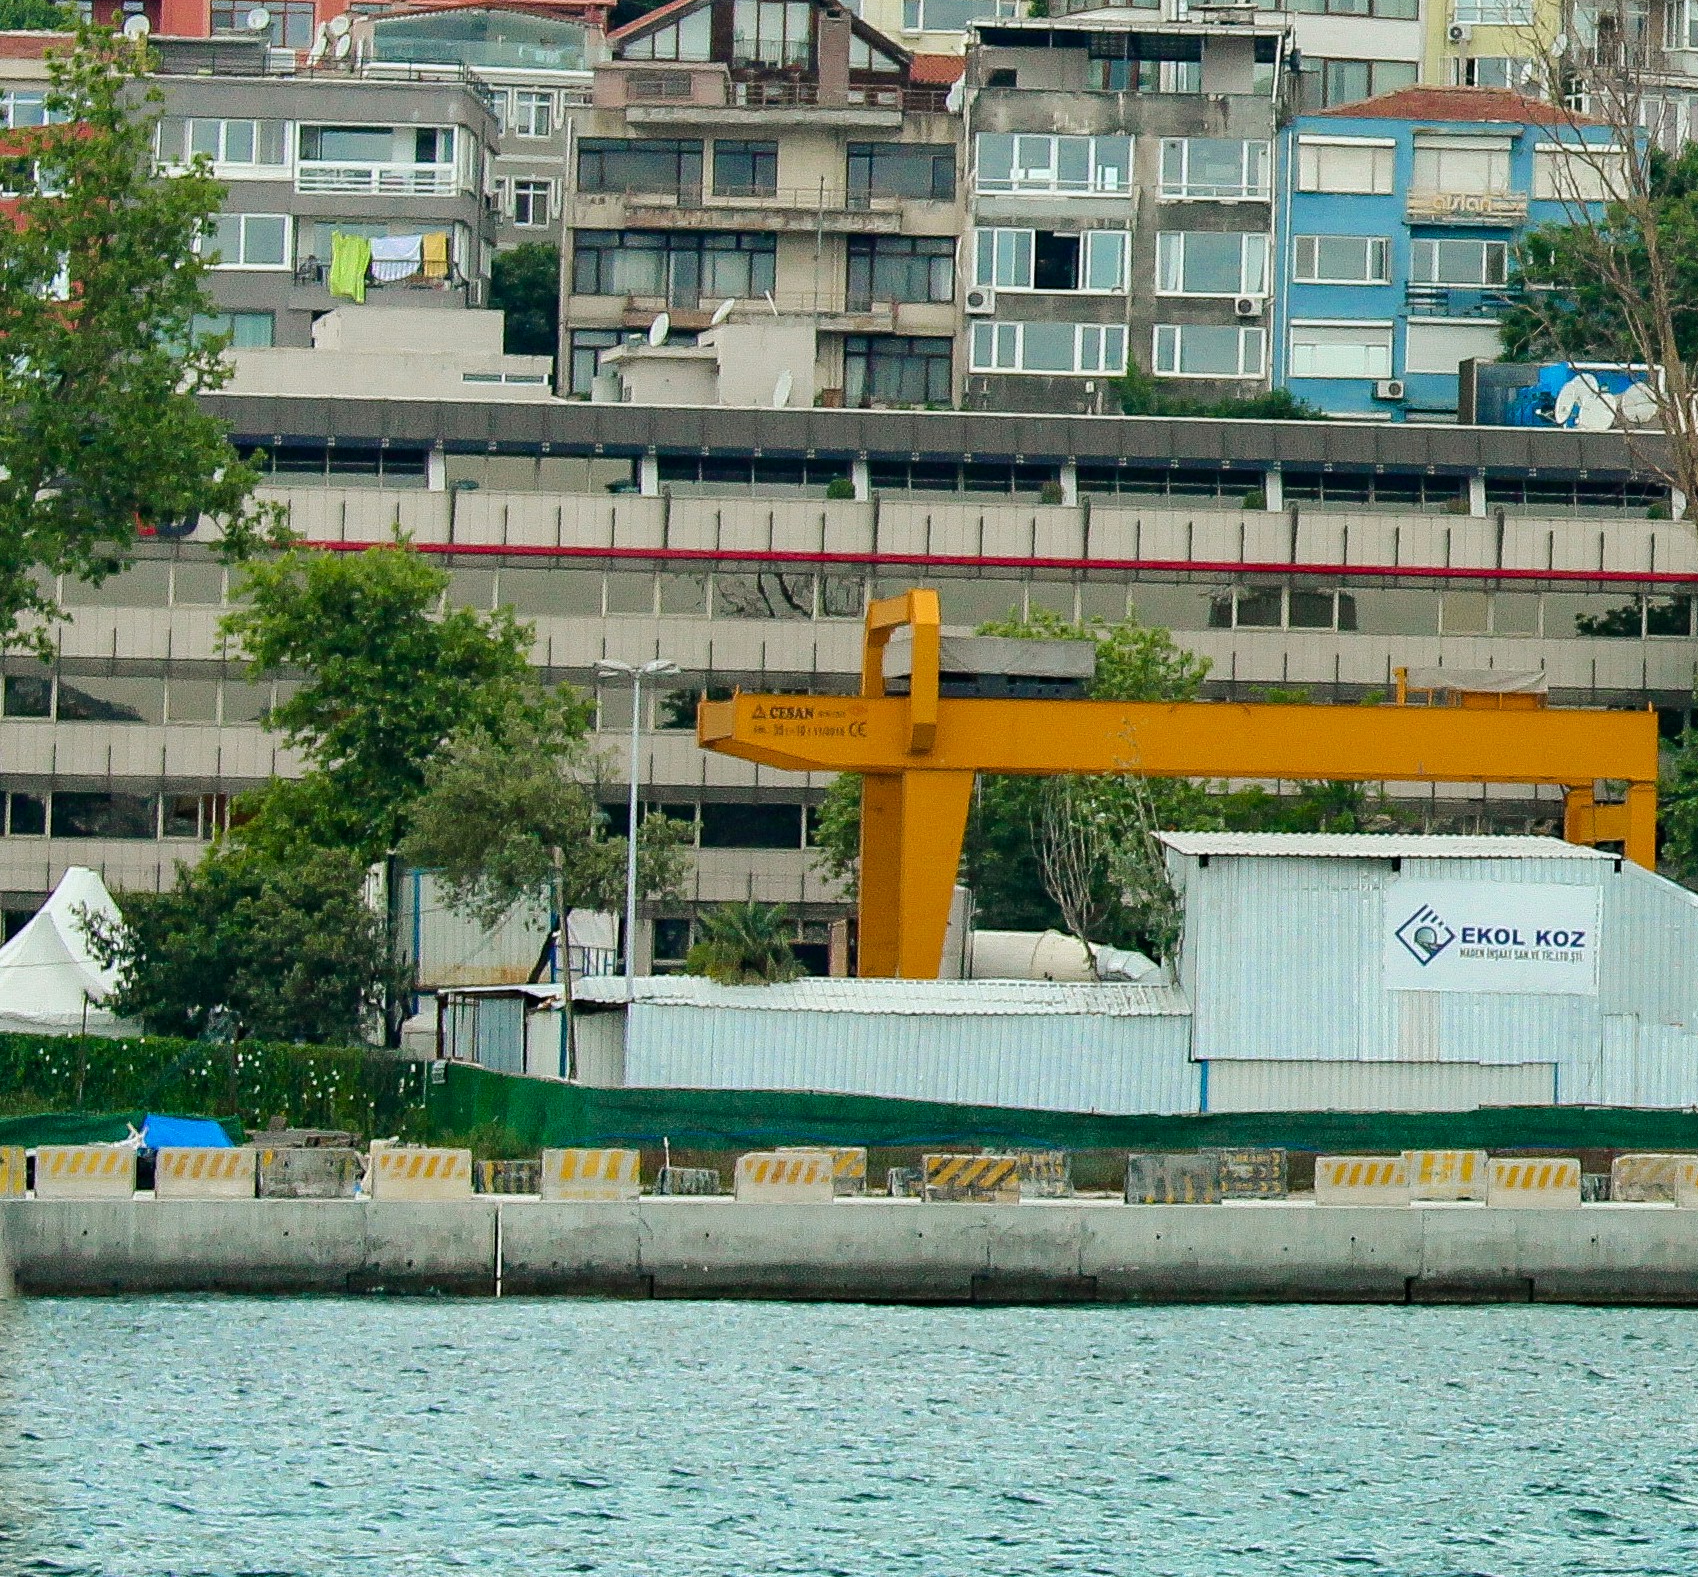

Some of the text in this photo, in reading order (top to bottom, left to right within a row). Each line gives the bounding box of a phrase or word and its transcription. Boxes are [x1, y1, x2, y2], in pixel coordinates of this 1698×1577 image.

[769, 706, 814, 720] CESAN
[1461, 927, 1585, 948] EKOL KOZ
